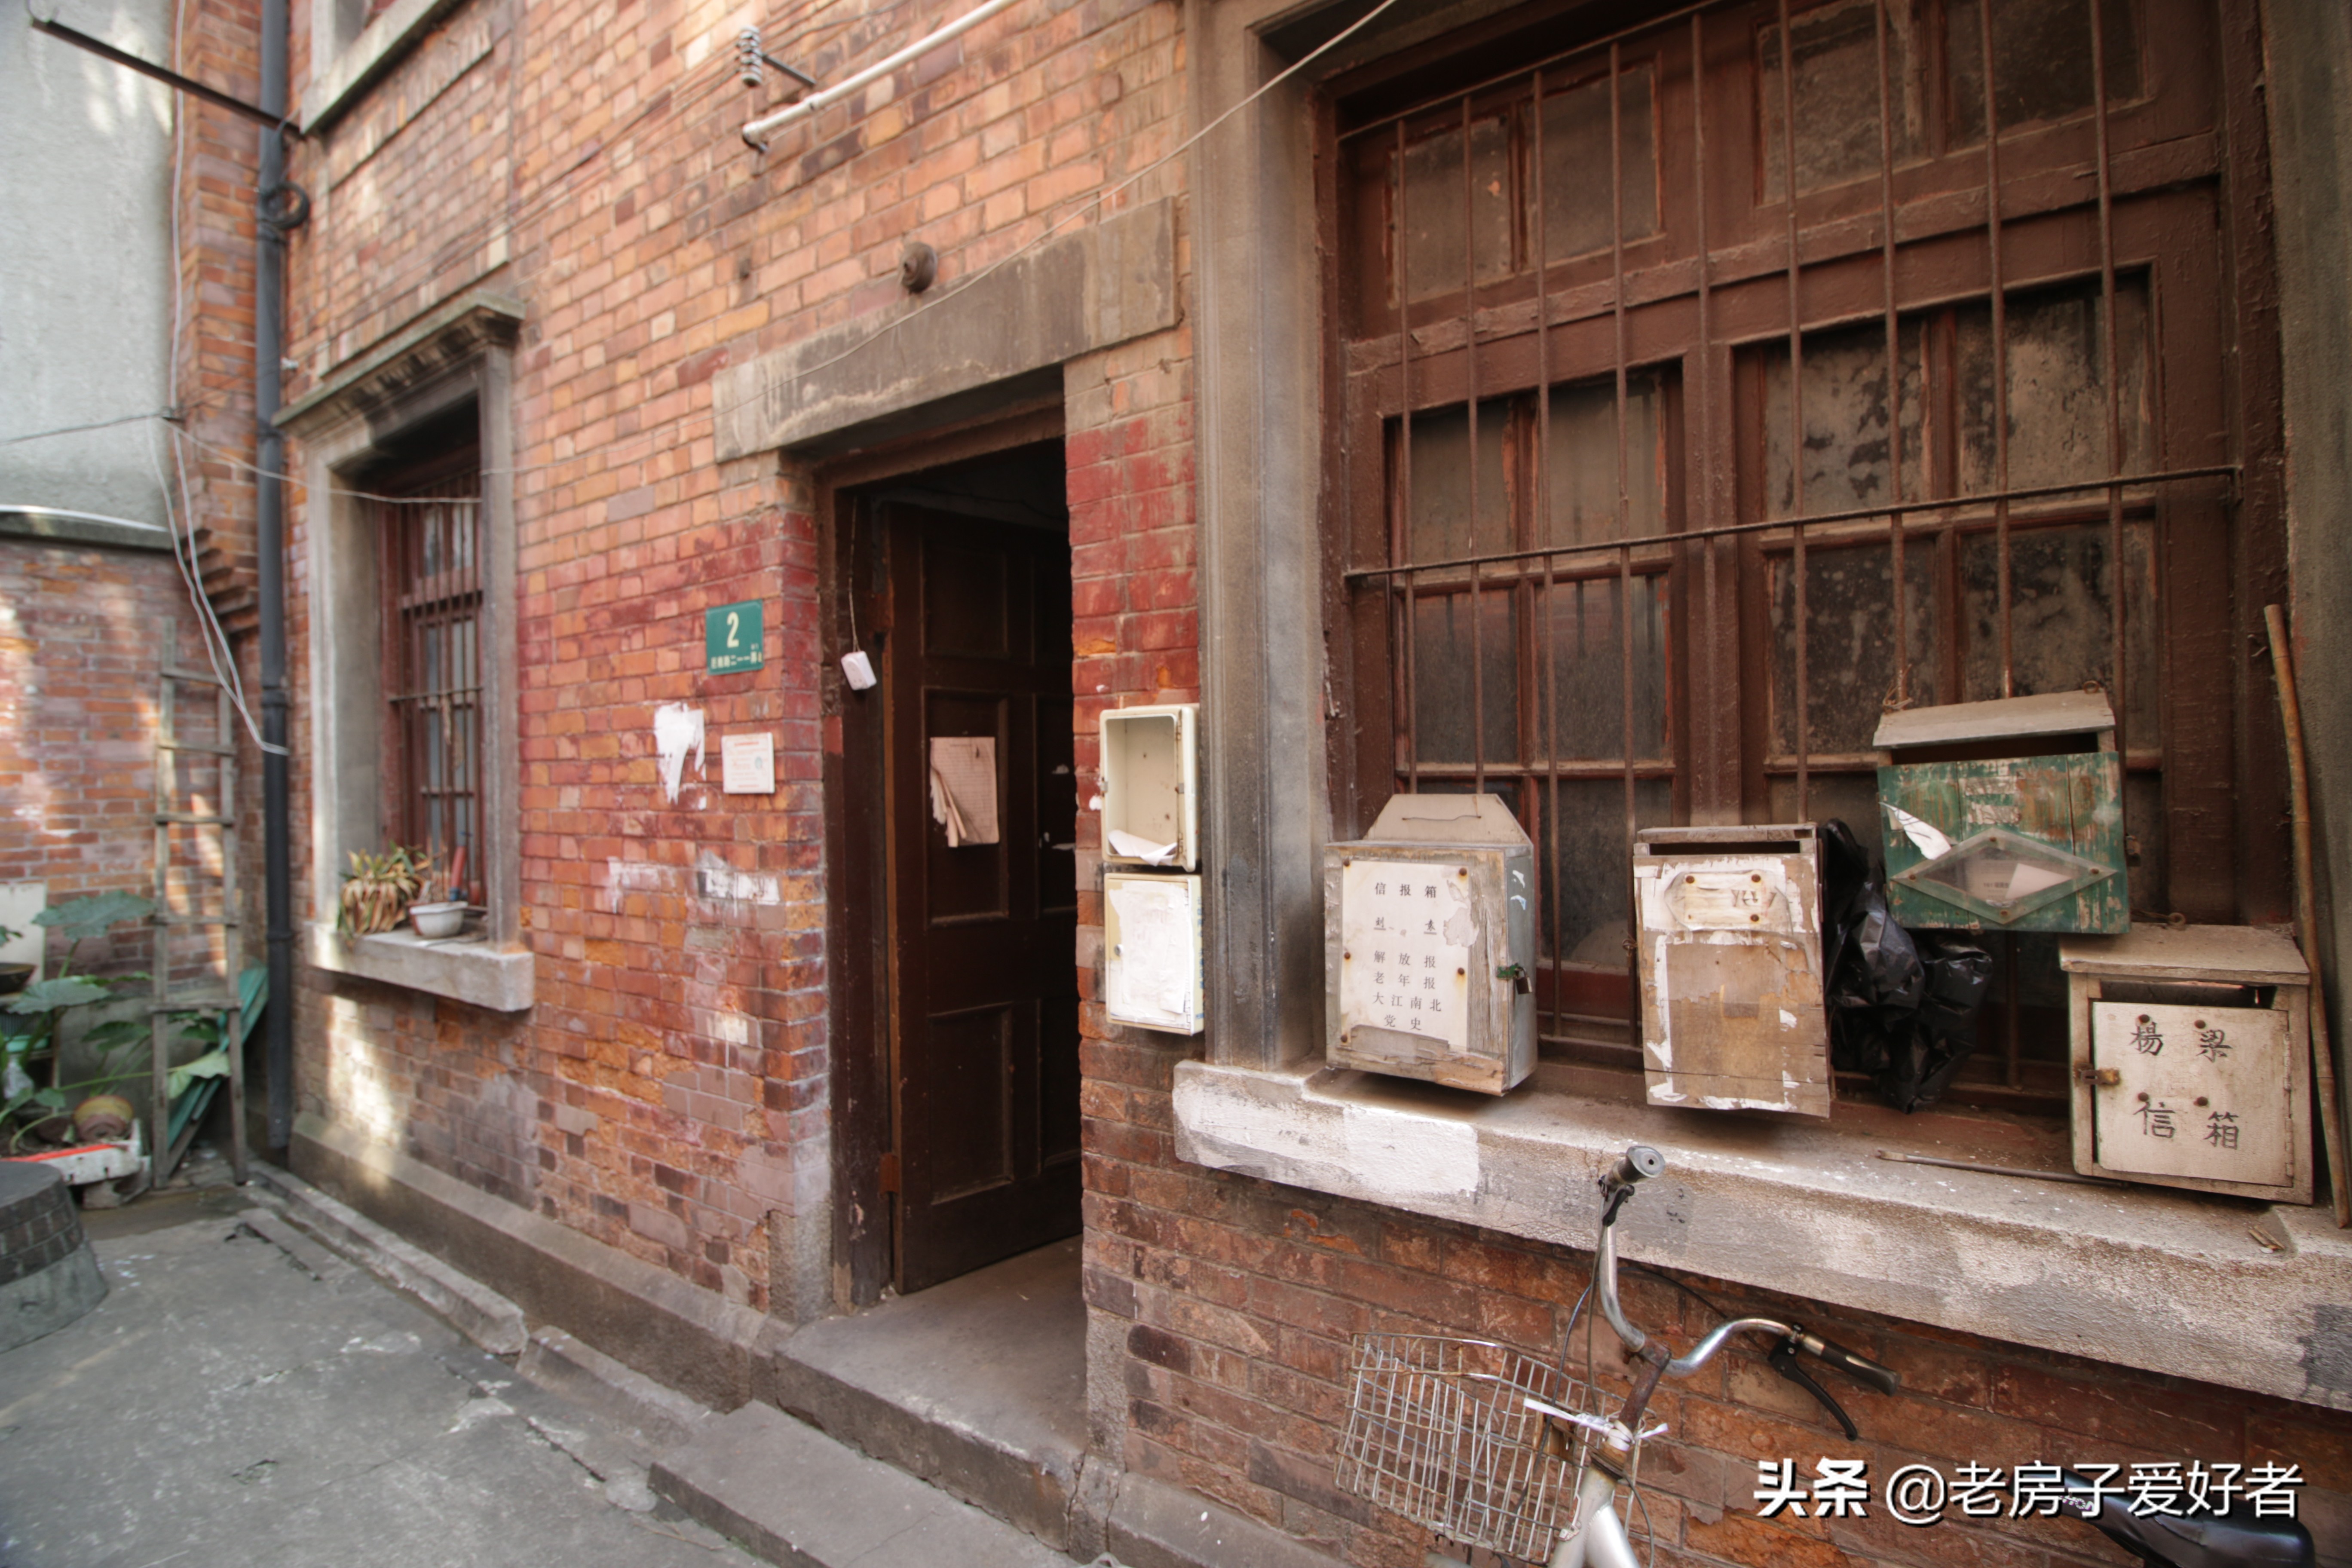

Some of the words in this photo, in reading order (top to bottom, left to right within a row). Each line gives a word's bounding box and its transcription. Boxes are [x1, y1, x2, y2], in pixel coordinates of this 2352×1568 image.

[727, 611, 739, 648] 2
[1375, 882, 1437, 898] 信报箱
[1373, 950, 1436, 968] 解放报
[1373, 971, 1436, 989] 老年报
[1372, 992, 1442, 1012] 大江南北
[1384, 1014, 1422, 1030] 党史
[2133, 1101, 2239, 1150] 信箱
